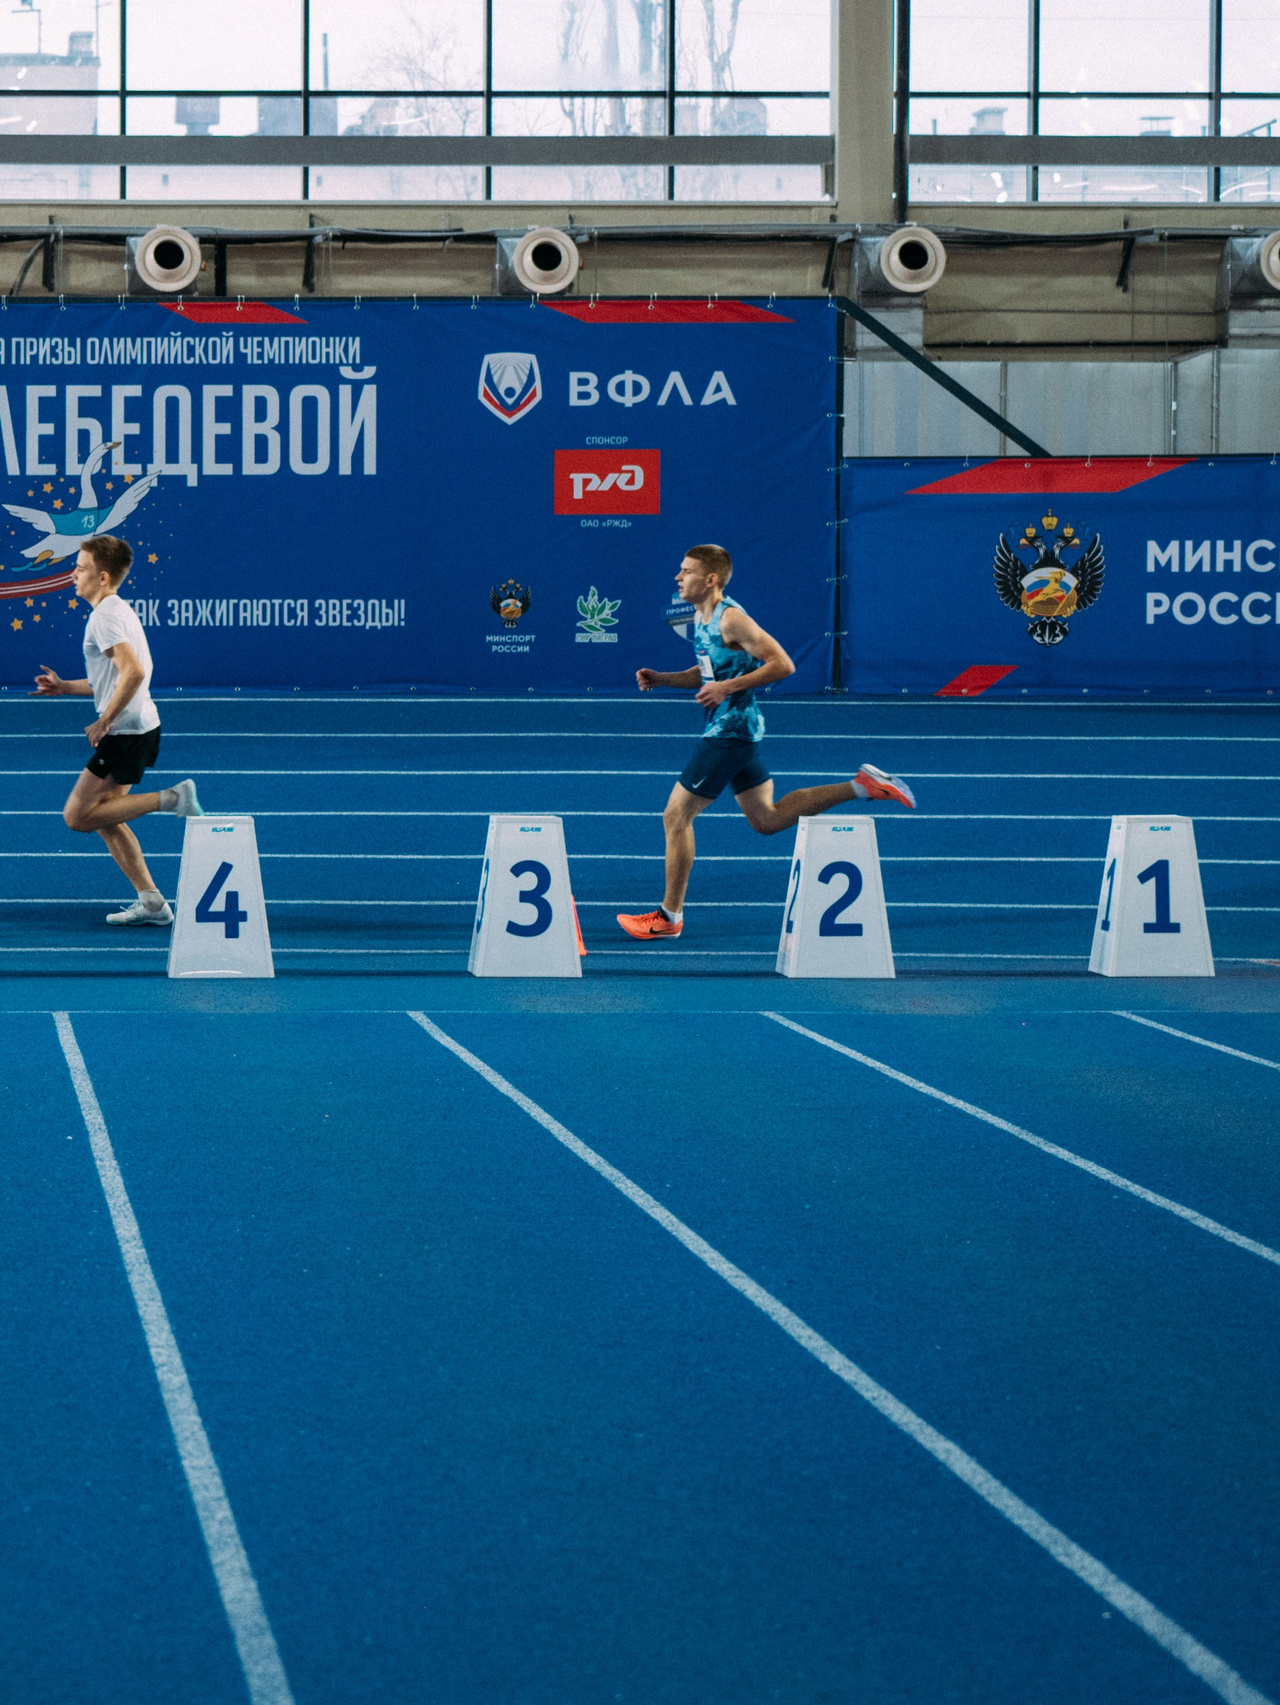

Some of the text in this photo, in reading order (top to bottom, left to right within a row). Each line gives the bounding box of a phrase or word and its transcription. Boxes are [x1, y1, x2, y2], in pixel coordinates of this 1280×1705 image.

[12, 338, 80, 364] ПРИЗЫ
[87, 332, 233, 364] ОЛИМПИЙСКОЙ
[240, 337, 360, 364] ЧЕМПИОНКИ
[569, 370, 737, 407] ВФЛА
[585, 436, 629, 445] СПОНСОР
[81, 515, 95, 528] 13
[580, 519, 632, 528] ОАО «РЖД»
[167, 599, 308, 627] ЗАЖИГАЮТСЯ
[315, 599, 406, 630] ЗВЕЗДЫ!
[1146, 591, 1280, 625] РОСС
[486, 635, 536, 643] МИНСПОРТ
[492, 645, 530, 653] РОССИИ
[195, 861, 248, 939] 4
[506, 860, 553, 937] 3
[785, 859, 801, 934] 2
[817, 861, 863, 936] 2
[1137, 859, 1181, 933] 1
